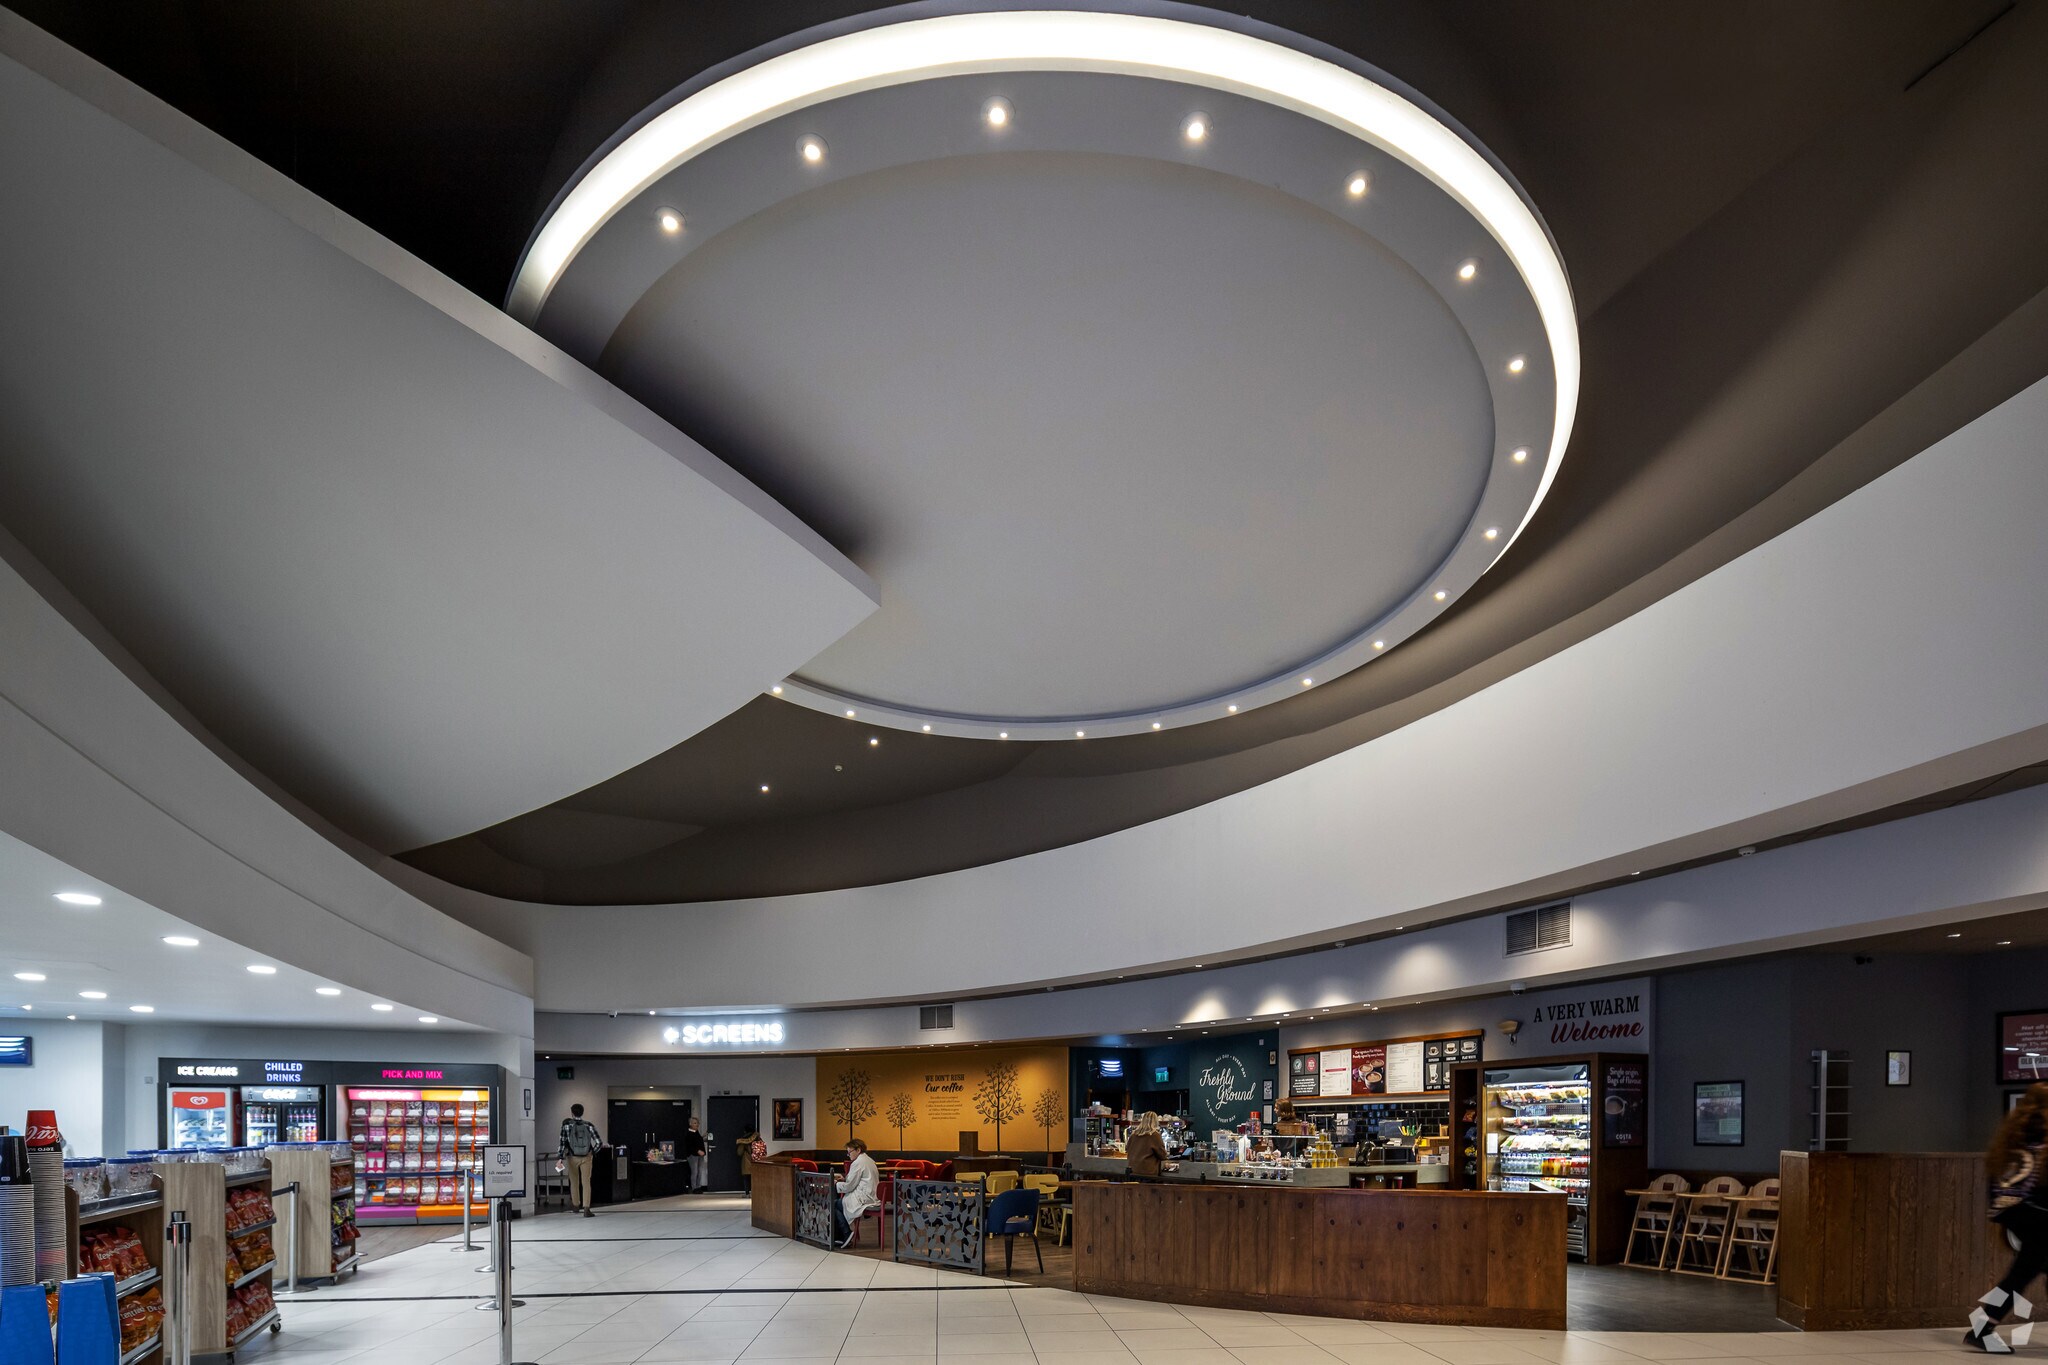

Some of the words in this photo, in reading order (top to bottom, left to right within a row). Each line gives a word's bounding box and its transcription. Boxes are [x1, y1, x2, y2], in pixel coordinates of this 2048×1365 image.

[1533, 1007, 1543, 1023] A
[1547, 1002, 1586, 1021] VERY
[1590, 995, 1640, 1017] WARM
[682, 1023, 784, 1044] SCREENS
[1550, 1020, 1645, 1044] Welcome
[177, 1066, 194, 1076] ICE
[195, 1066, 239, 1077] CREAMS
[264, 1062, 303, 1072] CHILLED
[1609, 1066, 1625, 1078] Single
[266, 1073, 301, 1082] DRINKS
[382, 1069, 403, 1078] PICK
[405, 1070, 424, 1079] AND
[425, 1070, 443, 1079] MIX
[935, 1074, 950, 1082] DON'T
[1199, 1067, 1235, 1093] Freshly
[1607, 1075, 1619, 1086] Bags
[1620, 1075, 1625, 1084] of
[925, 1083, 940, 1093] Our
[941, 1082, 964, 1093] coffee
[1215, 1082, 1256, 1110] Ground
